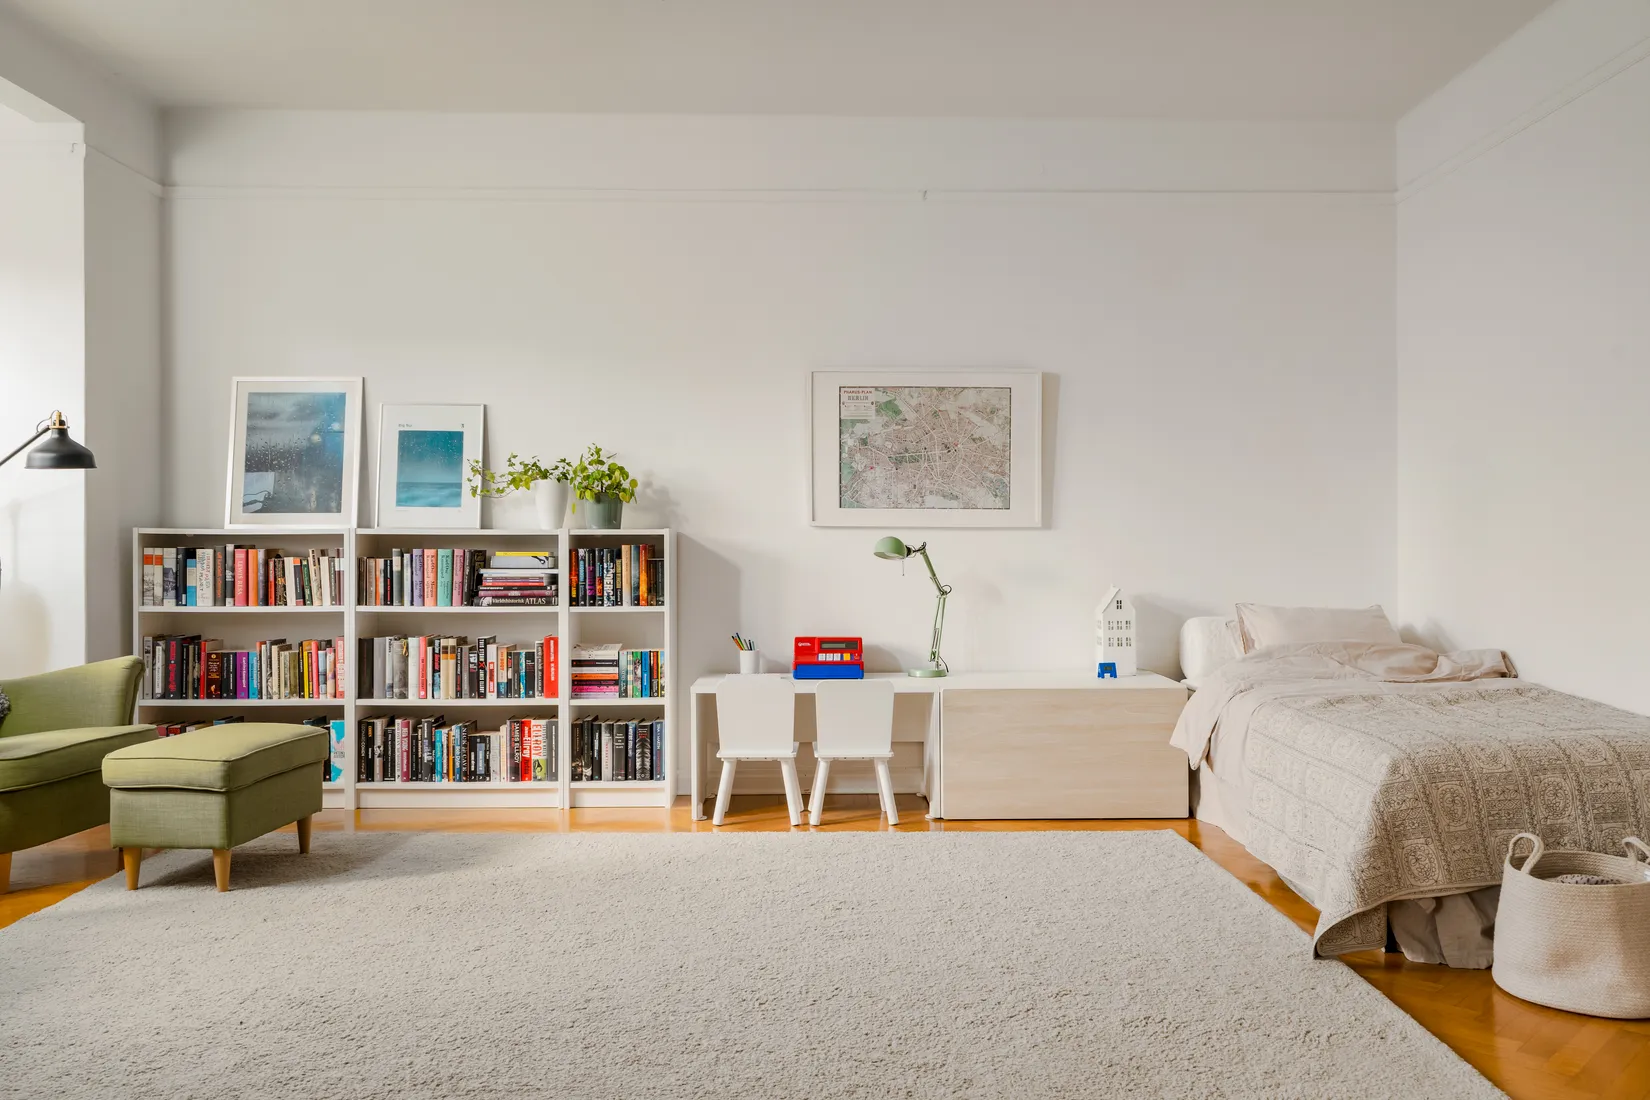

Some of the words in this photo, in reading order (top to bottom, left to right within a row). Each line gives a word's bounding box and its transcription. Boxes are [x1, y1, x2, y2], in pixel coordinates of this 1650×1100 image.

[525, 597, 547, 605] ATLAS
[522, 737, 532, 758] Ellroy
[532, 724, 543, 757] ELLROY
